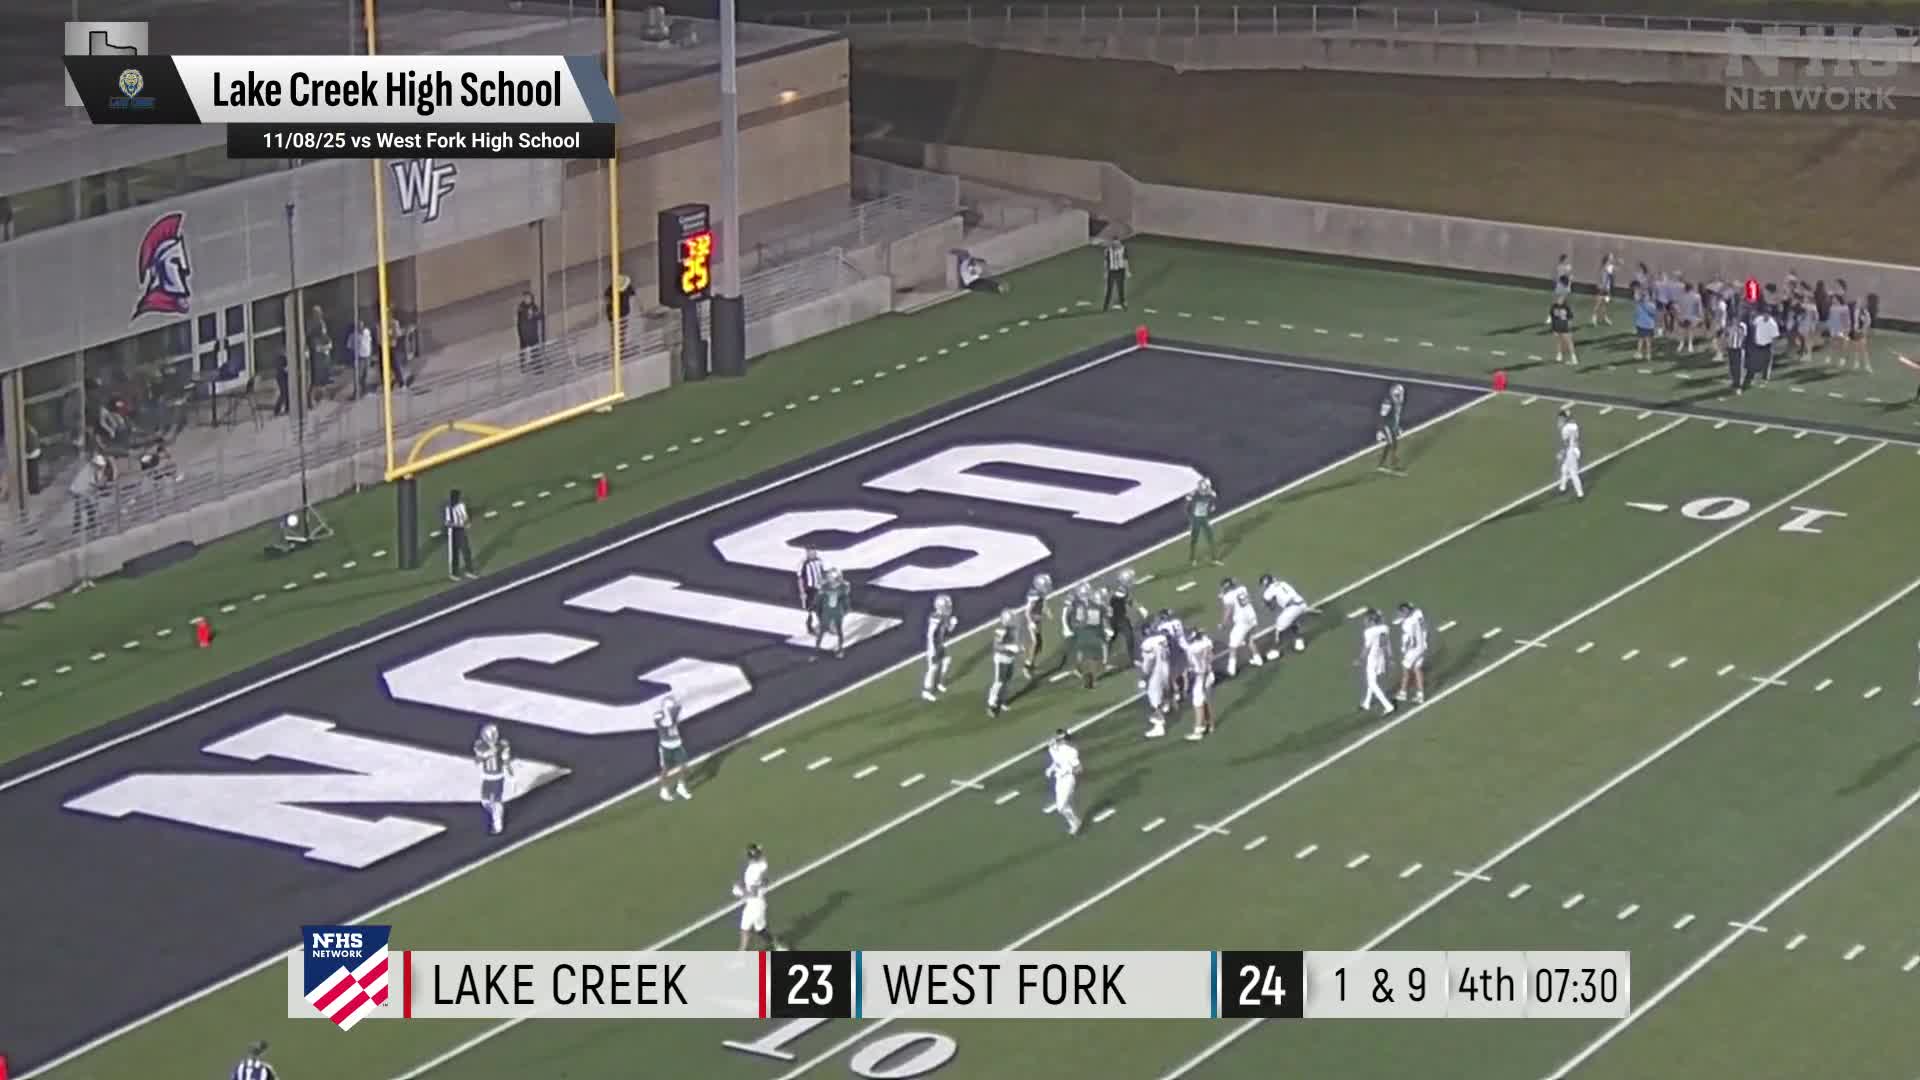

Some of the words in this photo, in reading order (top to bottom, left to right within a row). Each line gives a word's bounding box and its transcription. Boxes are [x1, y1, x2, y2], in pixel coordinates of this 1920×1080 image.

[389, 158, 457, 223] WF
[682, 257, 709, 293] 25
[62, 442, 1207, 868] NCISD
